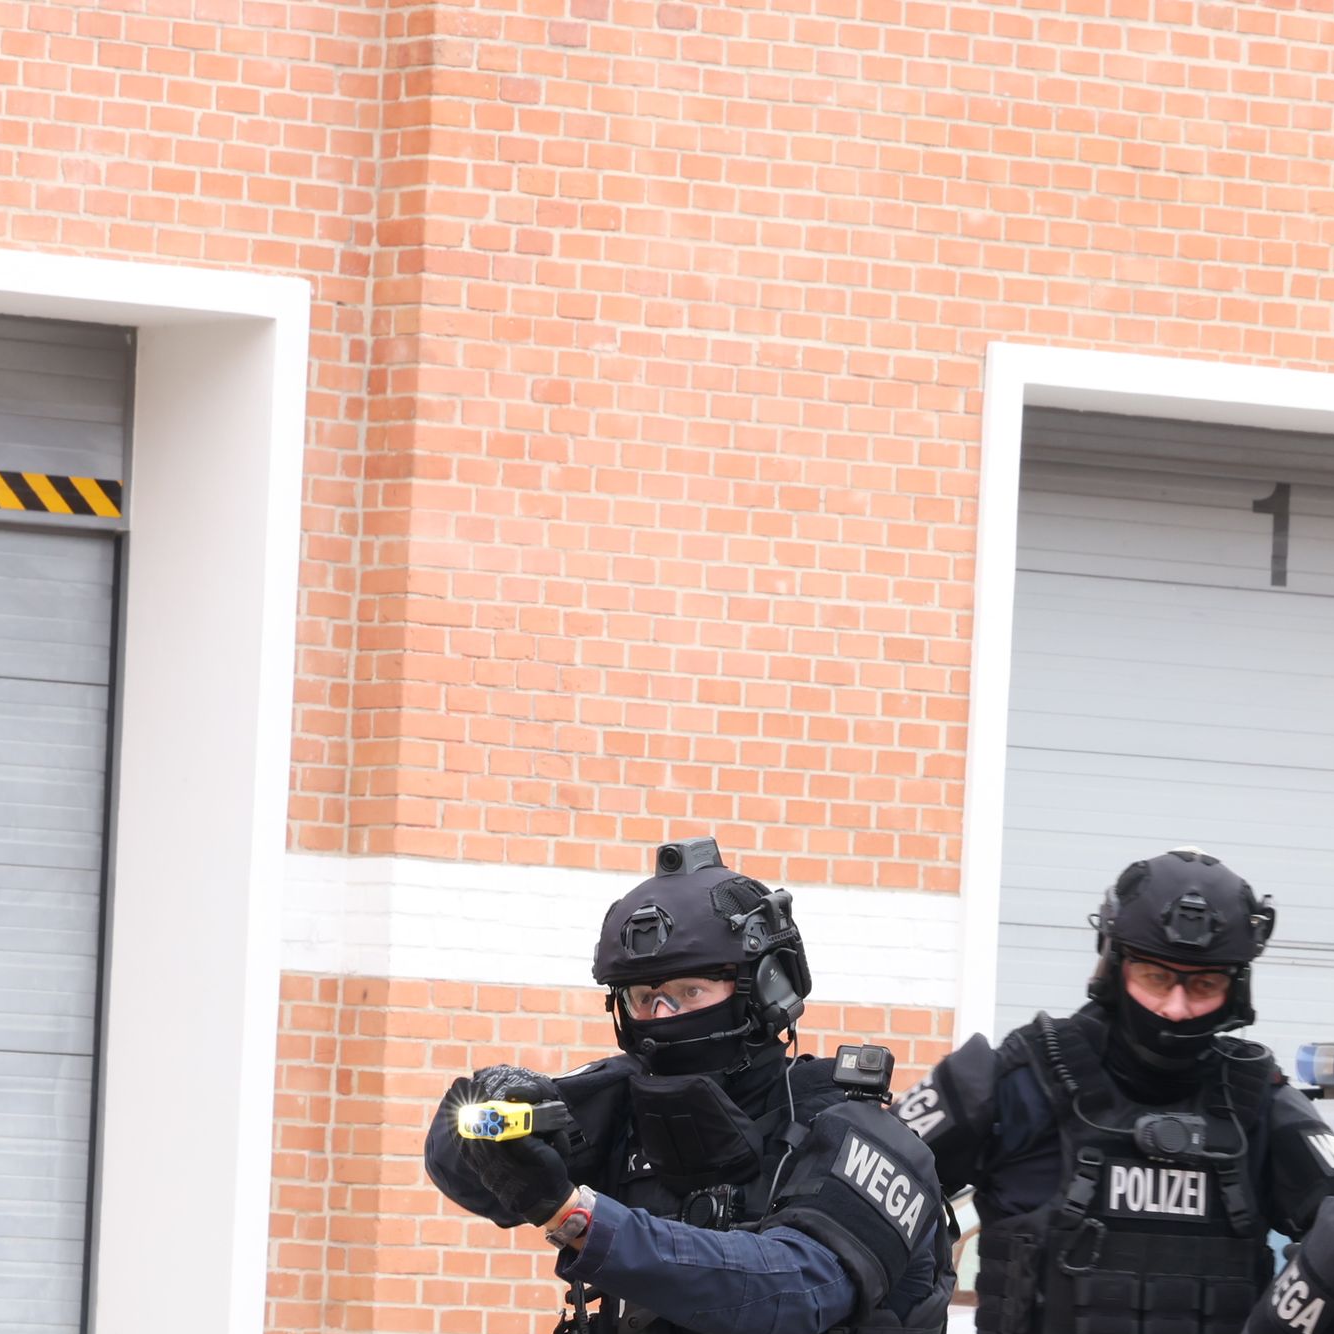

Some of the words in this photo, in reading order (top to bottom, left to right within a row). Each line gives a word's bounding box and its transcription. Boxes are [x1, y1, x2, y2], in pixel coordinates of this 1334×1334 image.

[1251, 481, 1291, 587] 1
[844, 1136, 925, 1239] WEGA
[1109, 1165, 1207, 1217] POLIZEI
